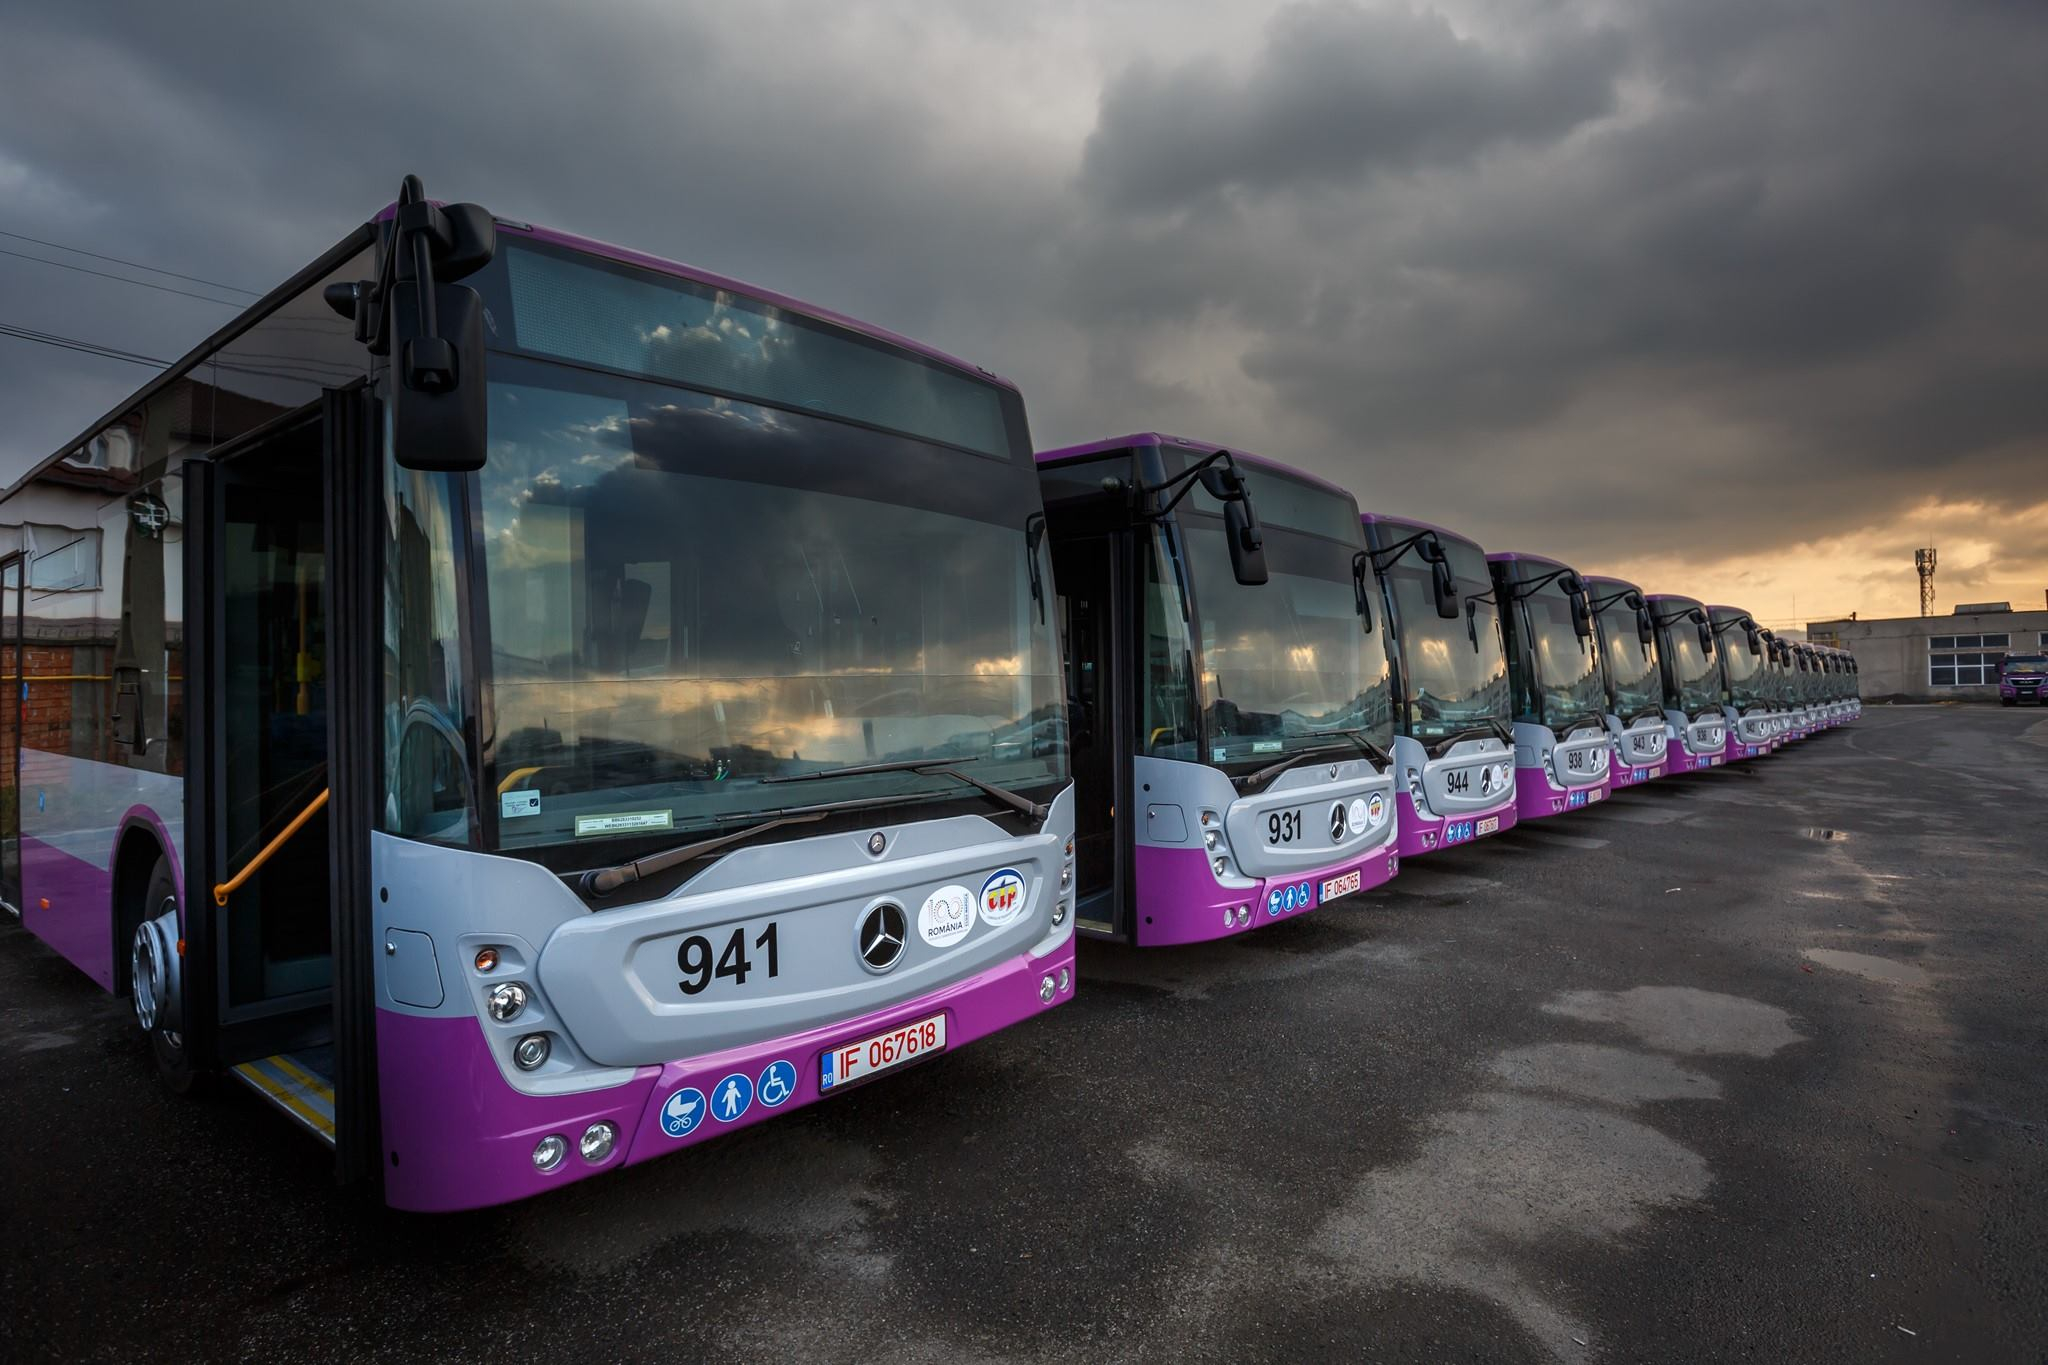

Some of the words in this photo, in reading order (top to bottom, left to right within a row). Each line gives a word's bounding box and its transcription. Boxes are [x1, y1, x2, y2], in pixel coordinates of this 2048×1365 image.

[1633, 736, 1646, 751] 943
[1568, 752, 1583, 770] 938
[1447, 771, 1469, 794] 944
[1268, 809, 1302, 845] 931
[1324, 882, 1332, 900] IF
[1334, 873, 1359, 896] 064765
[928, 921, 964, 937] ROMÂNIA
[676, 921, 780, 996] 941
[840, 1047, 860, 1079] IF
[870, 1022, 936, 1068] 067618
[822, 1072, 833, 1086] RO
